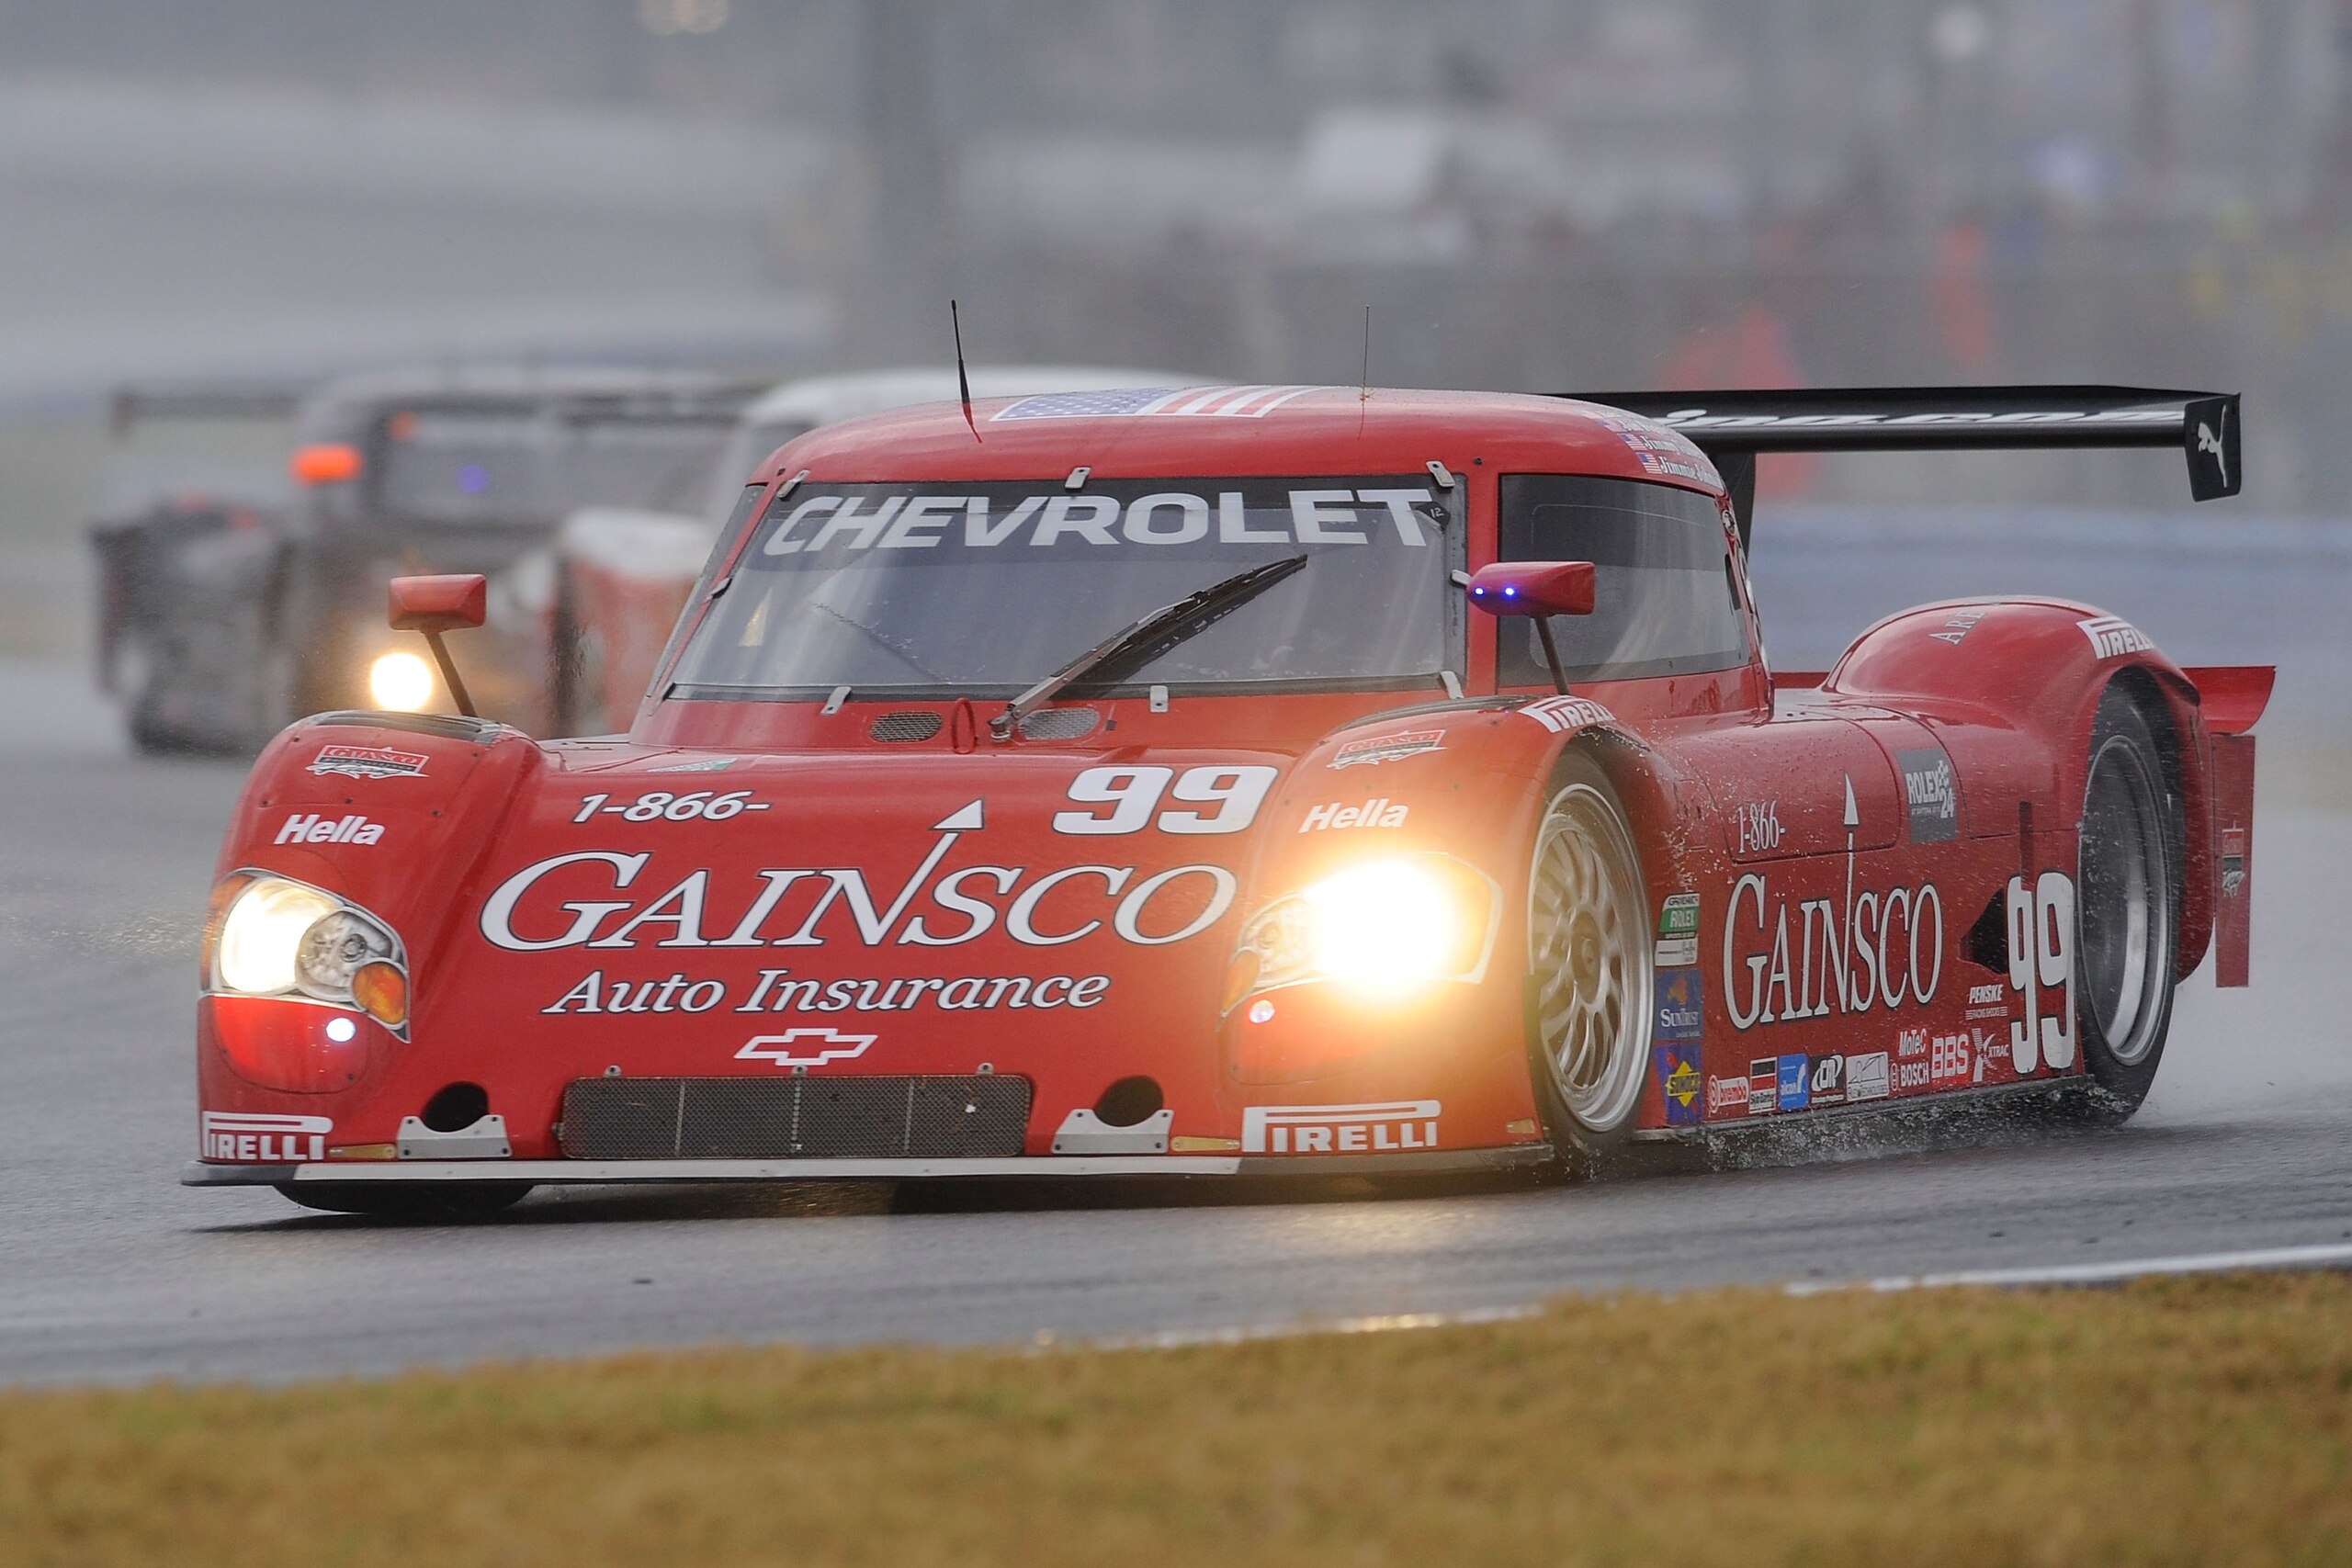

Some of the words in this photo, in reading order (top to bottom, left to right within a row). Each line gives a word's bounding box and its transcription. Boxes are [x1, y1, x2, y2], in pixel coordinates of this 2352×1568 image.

[1658, 456, 1696, 479] Jimmie
[763, 489, 1432, 556] CHEVROLET
[1430, 507, 1444, 519] 12
[1929, 610, 1985, 646] ARE
[1052, 765, 1280, 834] 99
[1905, 770, 1944, 805] ROLEX
[1939, 787, 1954, 818] 24
[572, 791, 771, 823] 1-866-
[1298, 798, 1409, 833] Hella
[273, 814, 385, 845] Hella
[1737, 800, 1786, 853] 1-866-
[479, 850, 1238, 952] GAINSCO
[1724, 874, 1943, 1030] GAINSCO
[2007, 871, 2075, 1074] 99
[541, 969, 727, 1014] Auto
[734, 968, 1112, 1013] Insurance
[1969, 985, 2004, 1004] PENSKE
[1898, 1028, 1927, 1056] MoTeC
[1931, 1034, 1969, 1078] BBS
[1988, 1044, 2009, 1057] XTRAC
[1900, 1063, 1929, 1087] BOSCH
[202, 1111, 334, 1160] PIRELLI
[1241, 1100, 1442, 1152] PIRELLI
